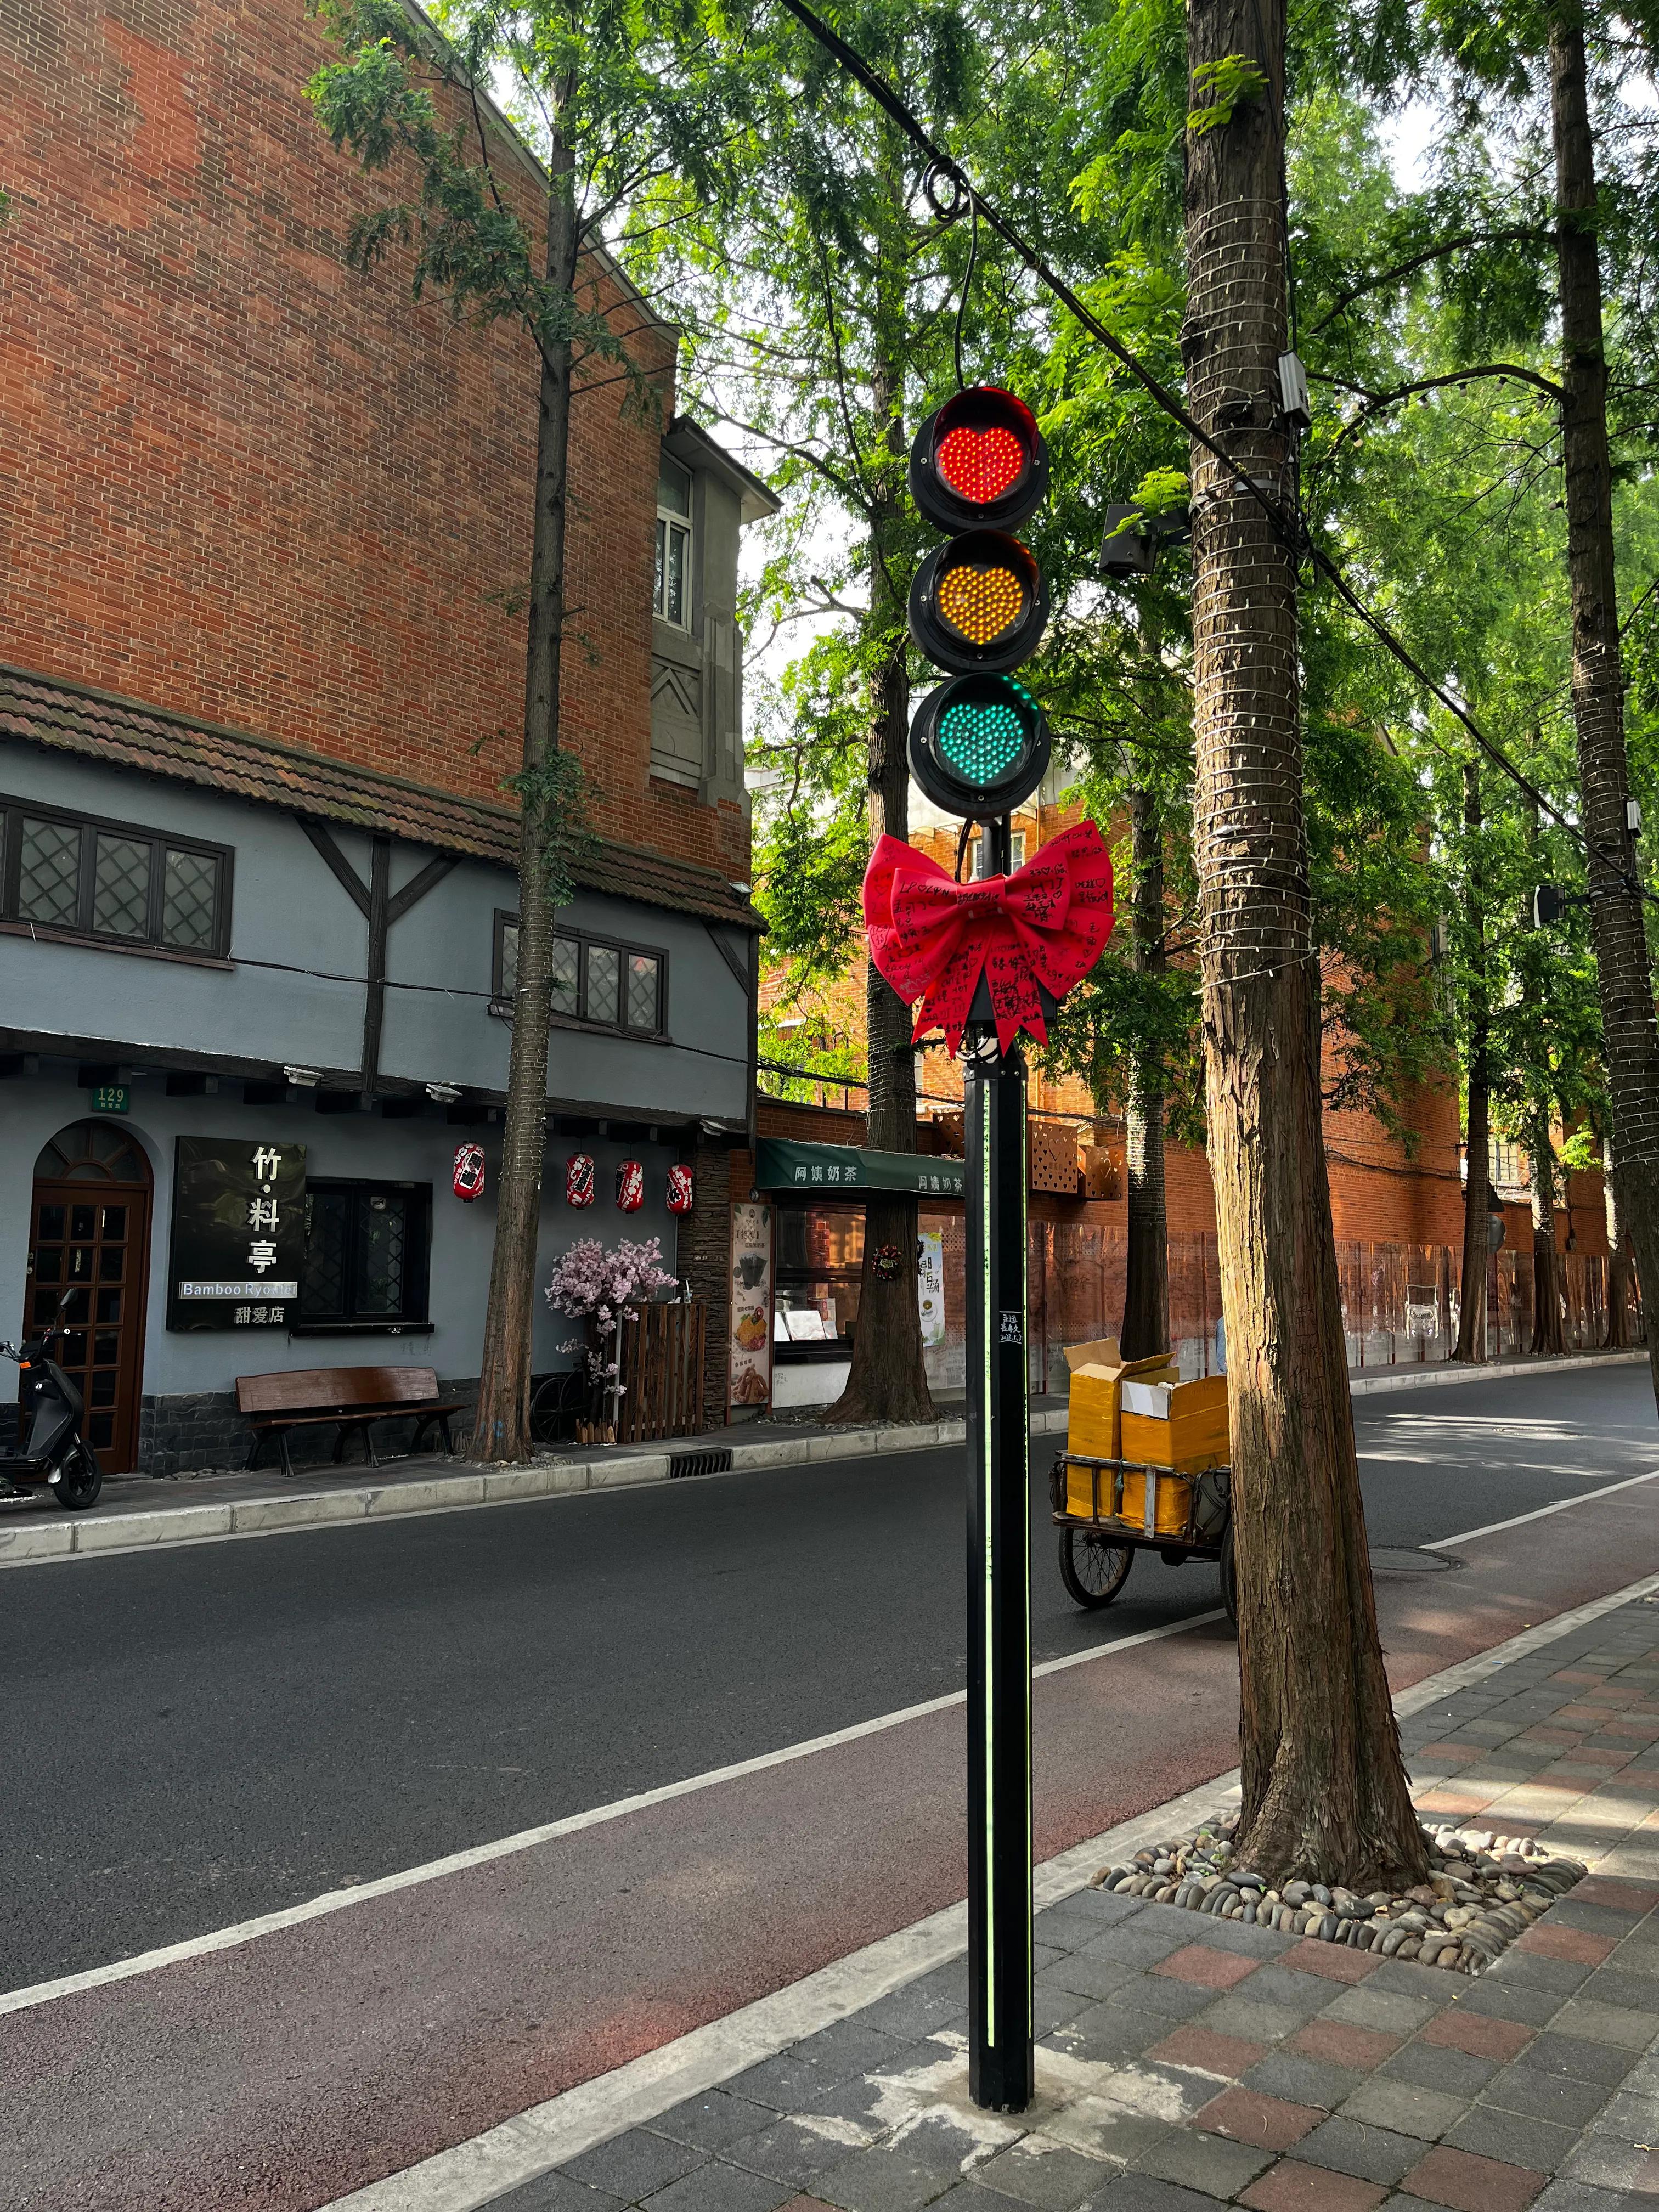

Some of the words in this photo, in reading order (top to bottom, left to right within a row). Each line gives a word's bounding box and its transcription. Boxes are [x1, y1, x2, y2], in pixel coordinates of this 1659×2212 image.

[99, 1087, 123, 1102] 129
[795, 1165, 857, 1182] 阿姨奶茶
[918, 1175, 963, 1192] 阿姨奶茶
[183, 1284, 241, 1295] Bamboo
[234, 1306, 285, 1324] 甜爱店
